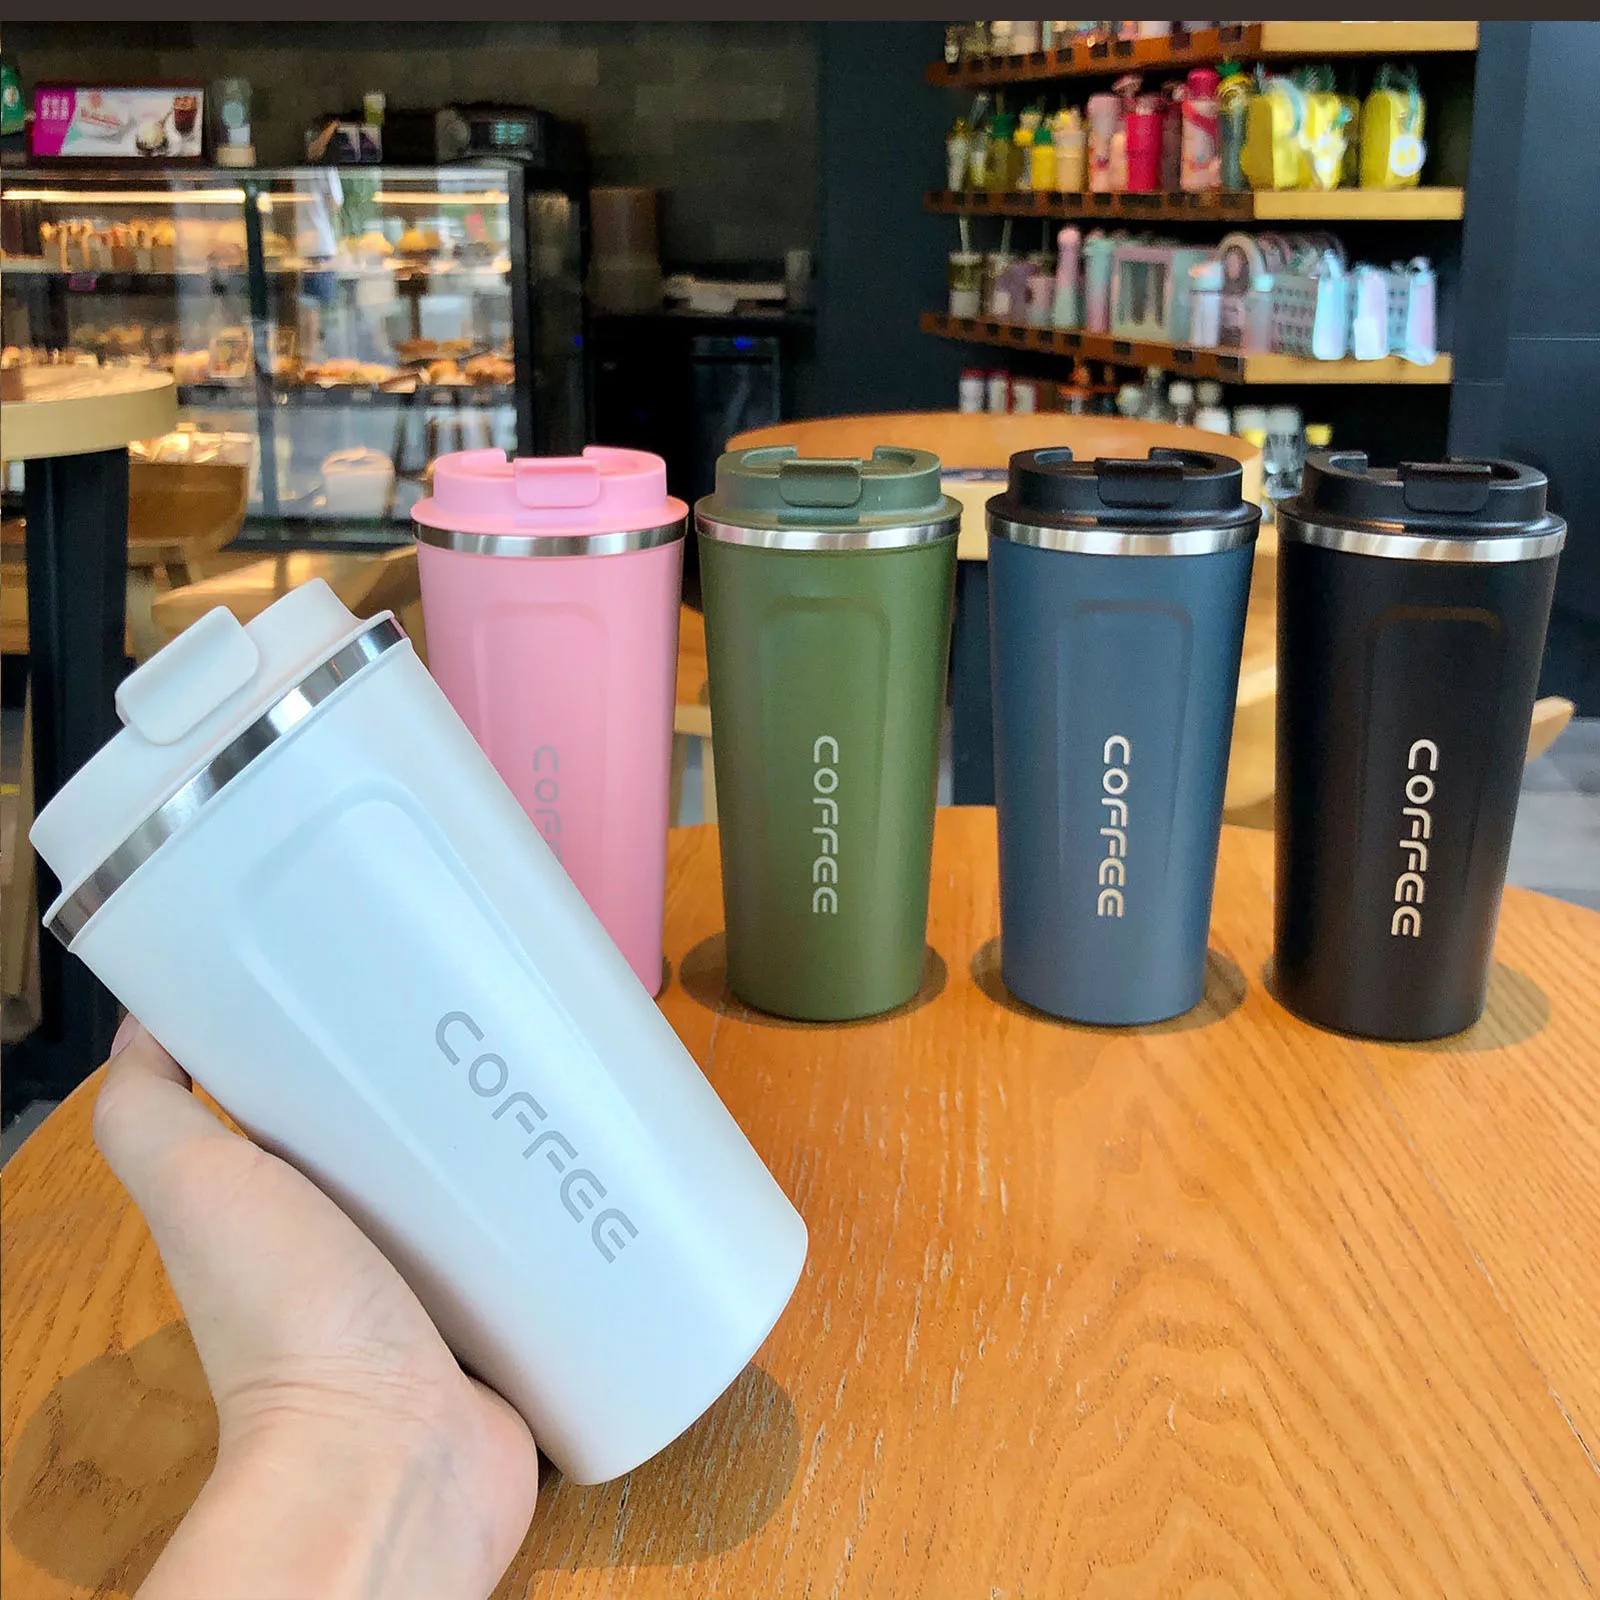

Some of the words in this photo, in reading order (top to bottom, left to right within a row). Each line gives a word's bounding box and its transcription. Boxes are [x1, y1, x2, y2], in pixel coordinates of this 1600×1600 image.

[812, 735, 839, 914] COFFEE
[1097, 734, 1130, 918] COFFEE
[1391, 738, 1438, 938] COFFEE
[435, 1010, 639, 1264] COFFEE
